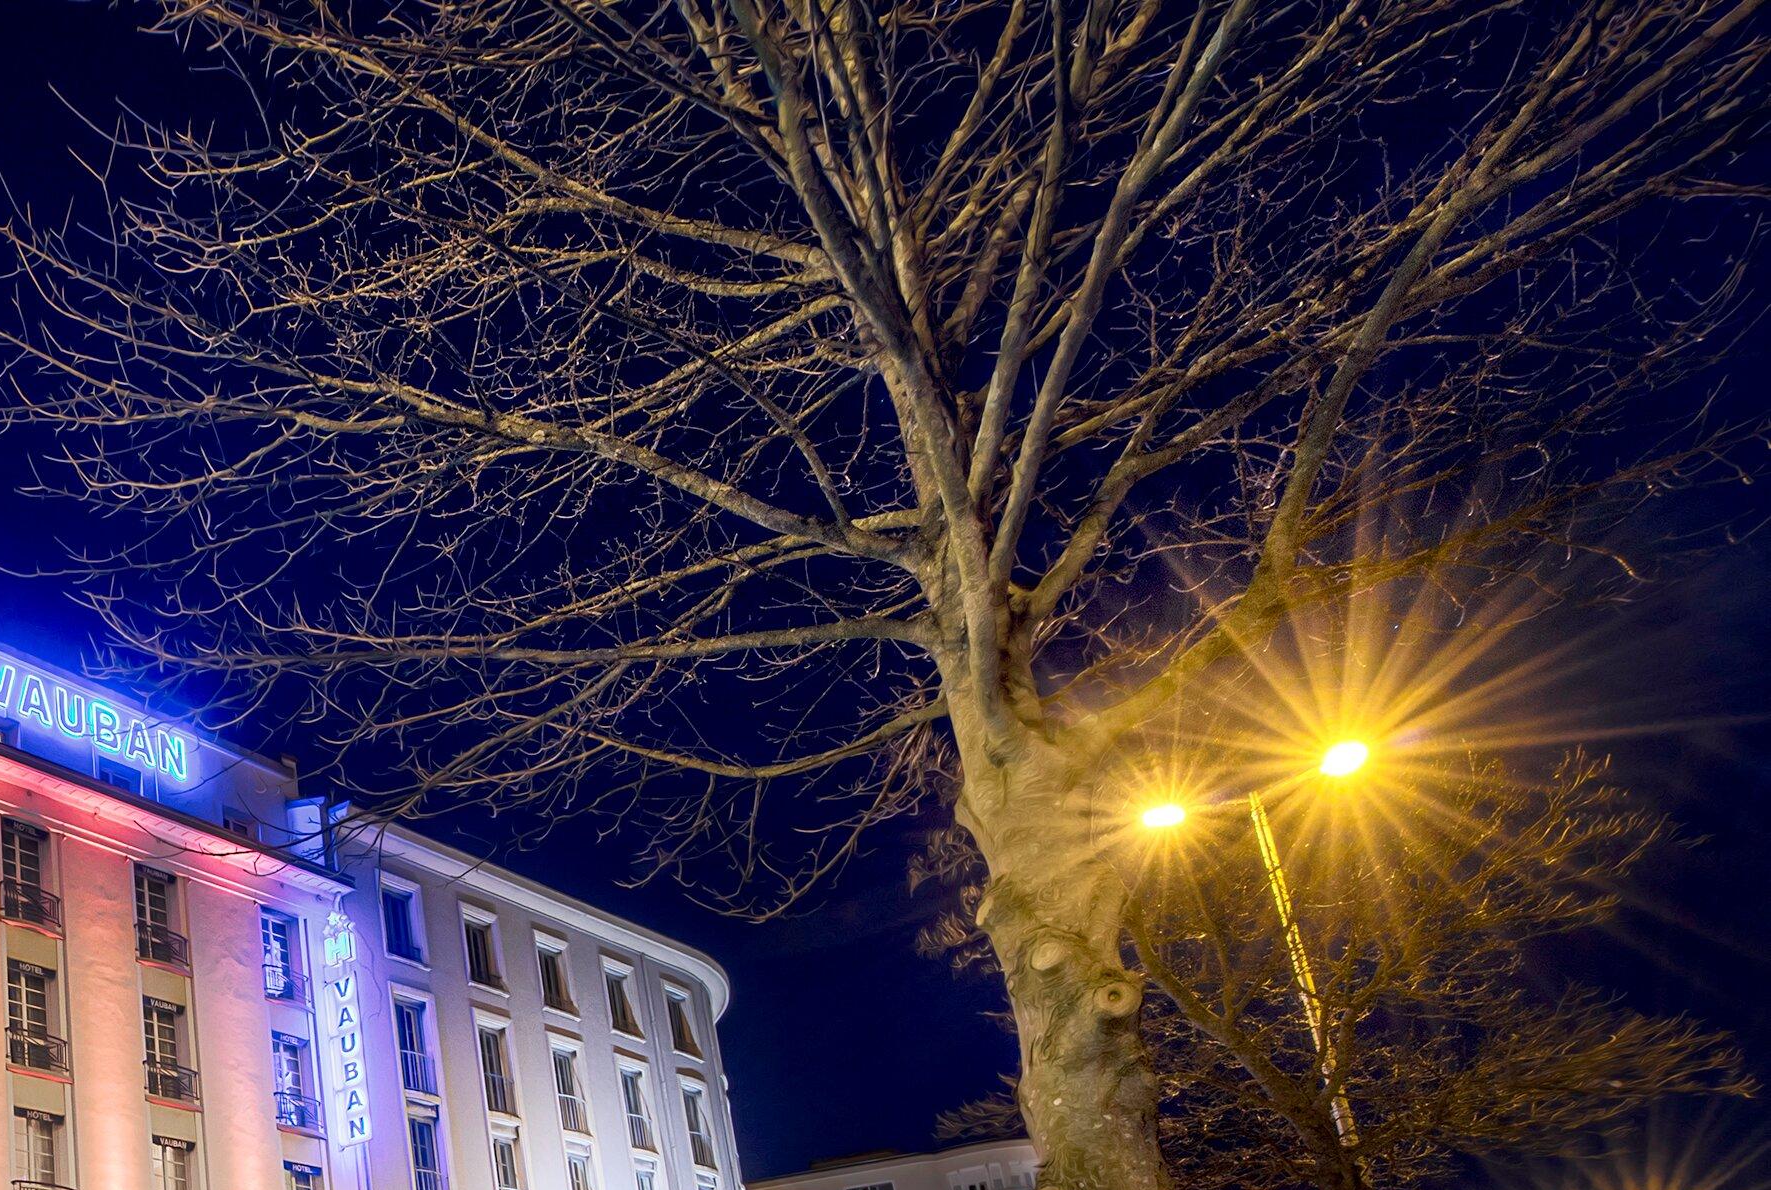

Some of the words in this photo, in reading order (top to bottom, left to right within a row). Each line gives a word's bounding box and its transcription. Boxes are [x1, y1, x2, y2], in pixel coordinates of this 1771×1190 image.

[12, 821, 37, 836] HOTEL
[18, 963, 44, 976] HOTEL
[149, 998, 177, 1013] VAUBAN
[334, 977, 366, 1140] VAUBAN
[26, 1110, 52, 1122] HOTEL
[159, 1136, 187, 1150] VAUBAN
[292, 1163, 313, 1174] HOTEL
